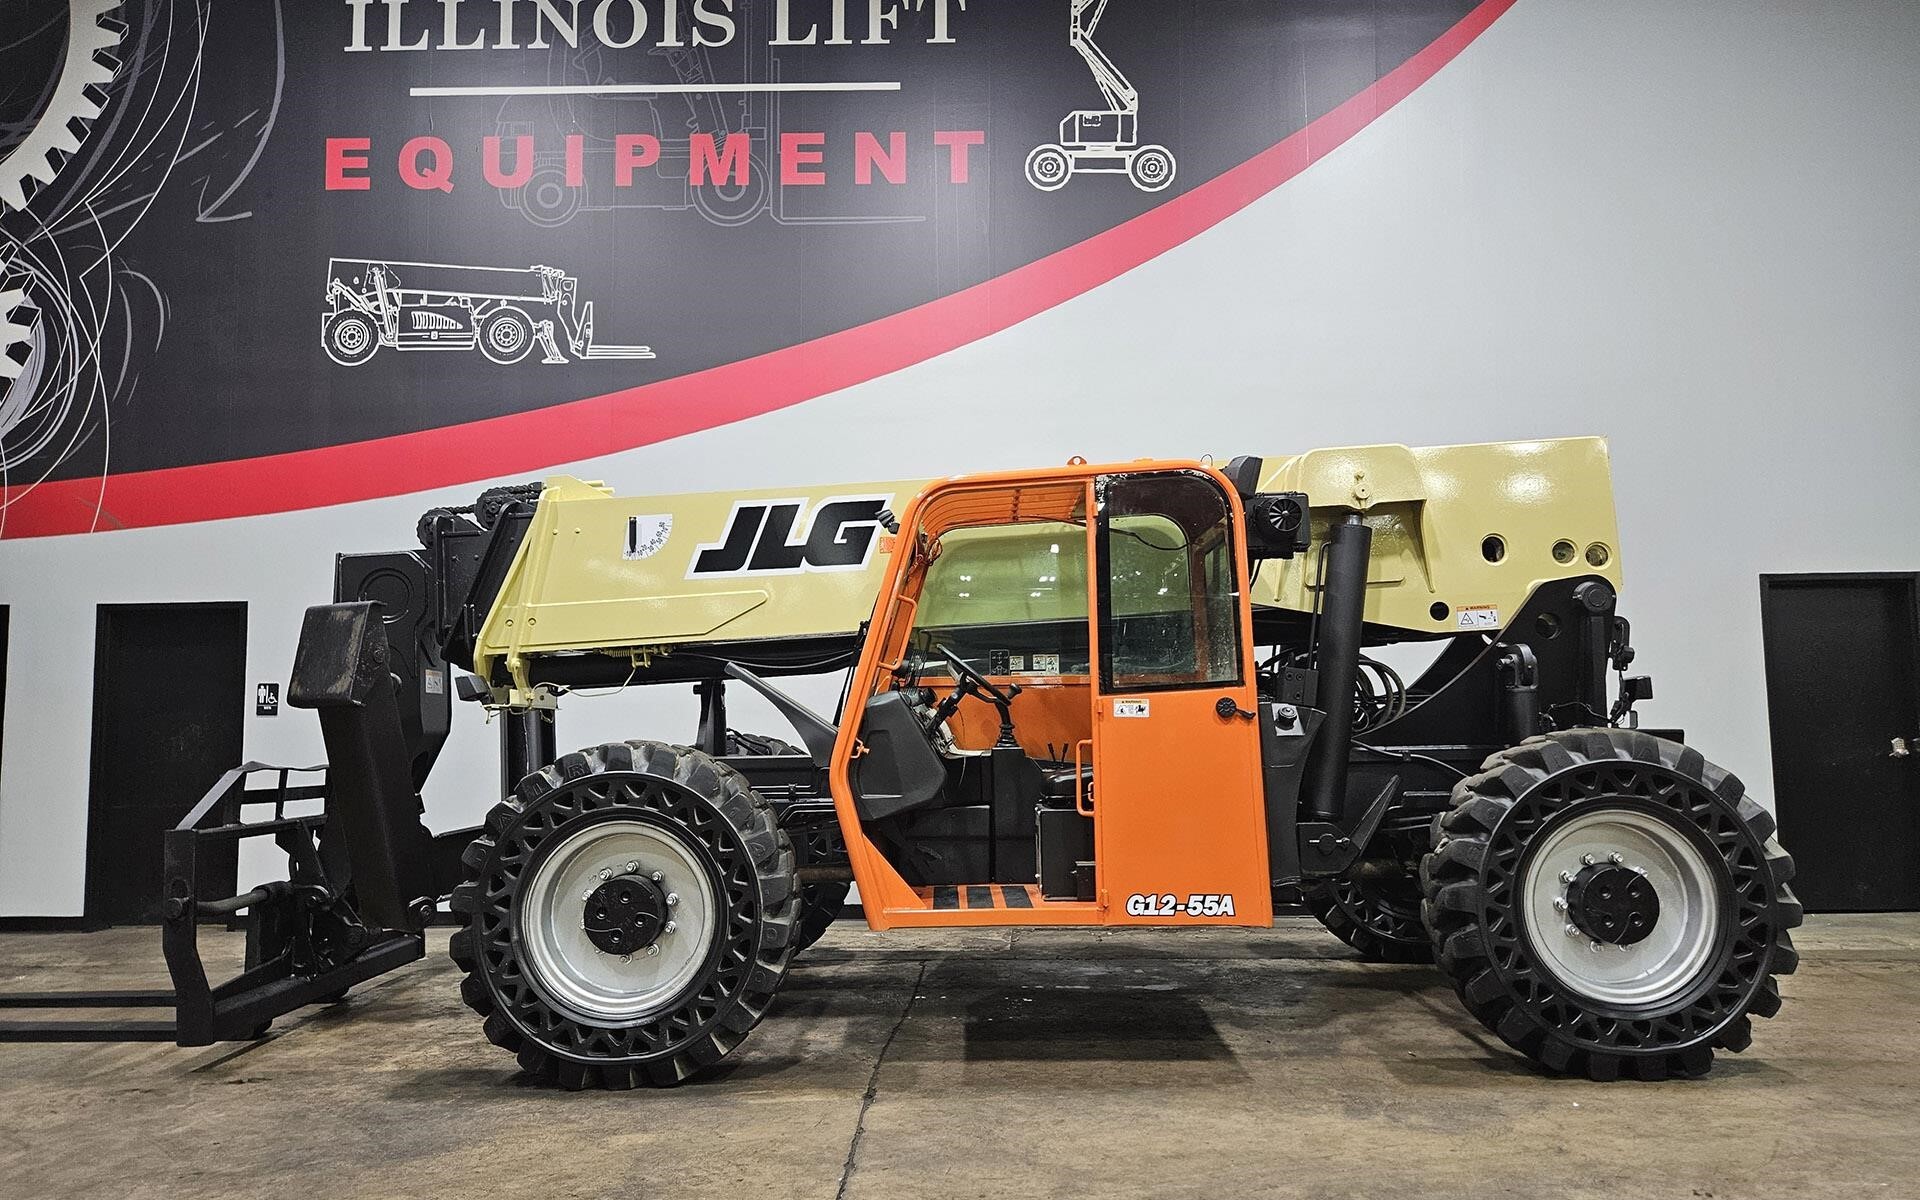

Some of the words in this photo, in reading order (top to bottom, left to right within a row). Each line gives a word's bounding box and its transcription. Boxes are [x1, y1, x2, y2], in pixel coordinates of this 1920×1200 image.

[344, 0, 735, 52] ILLINOIS
[768, 0, 966, 45] LIFT
[325, 130, 985, 193] EQUIPMENT
[691, 498, 888, 575] JLG
[1126, 893, 1236, 916] G12-55A
